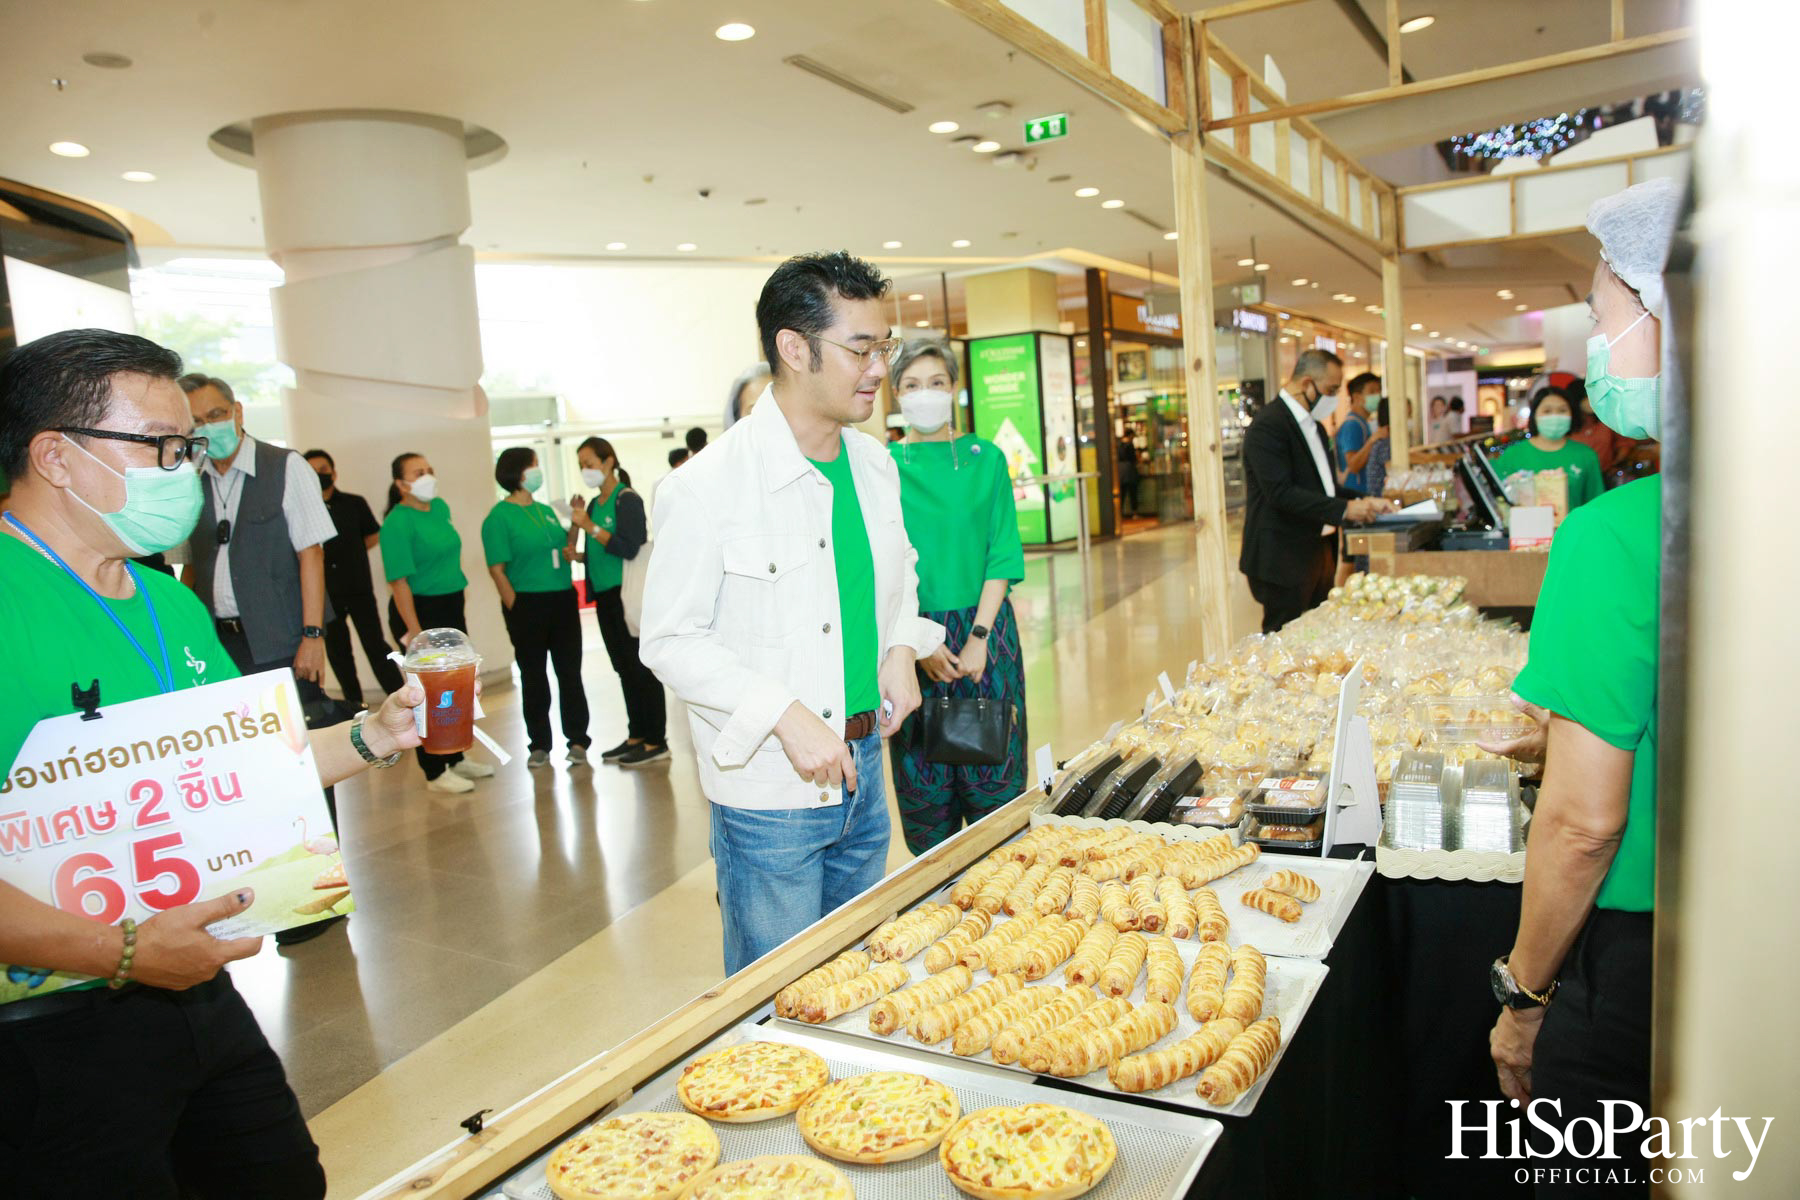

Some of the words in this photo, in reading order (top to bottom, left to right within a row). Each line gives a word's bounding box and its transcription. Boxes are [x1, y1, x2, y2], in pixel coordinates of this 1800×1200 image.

[0, 800, 117, 853] พิเศษ
[129, 778, 171, 827] 2
[177, 757, 243, 809] ชิ้น
[55, 832, 201, 927] 65
[207, 849, 253, 872] บาท
